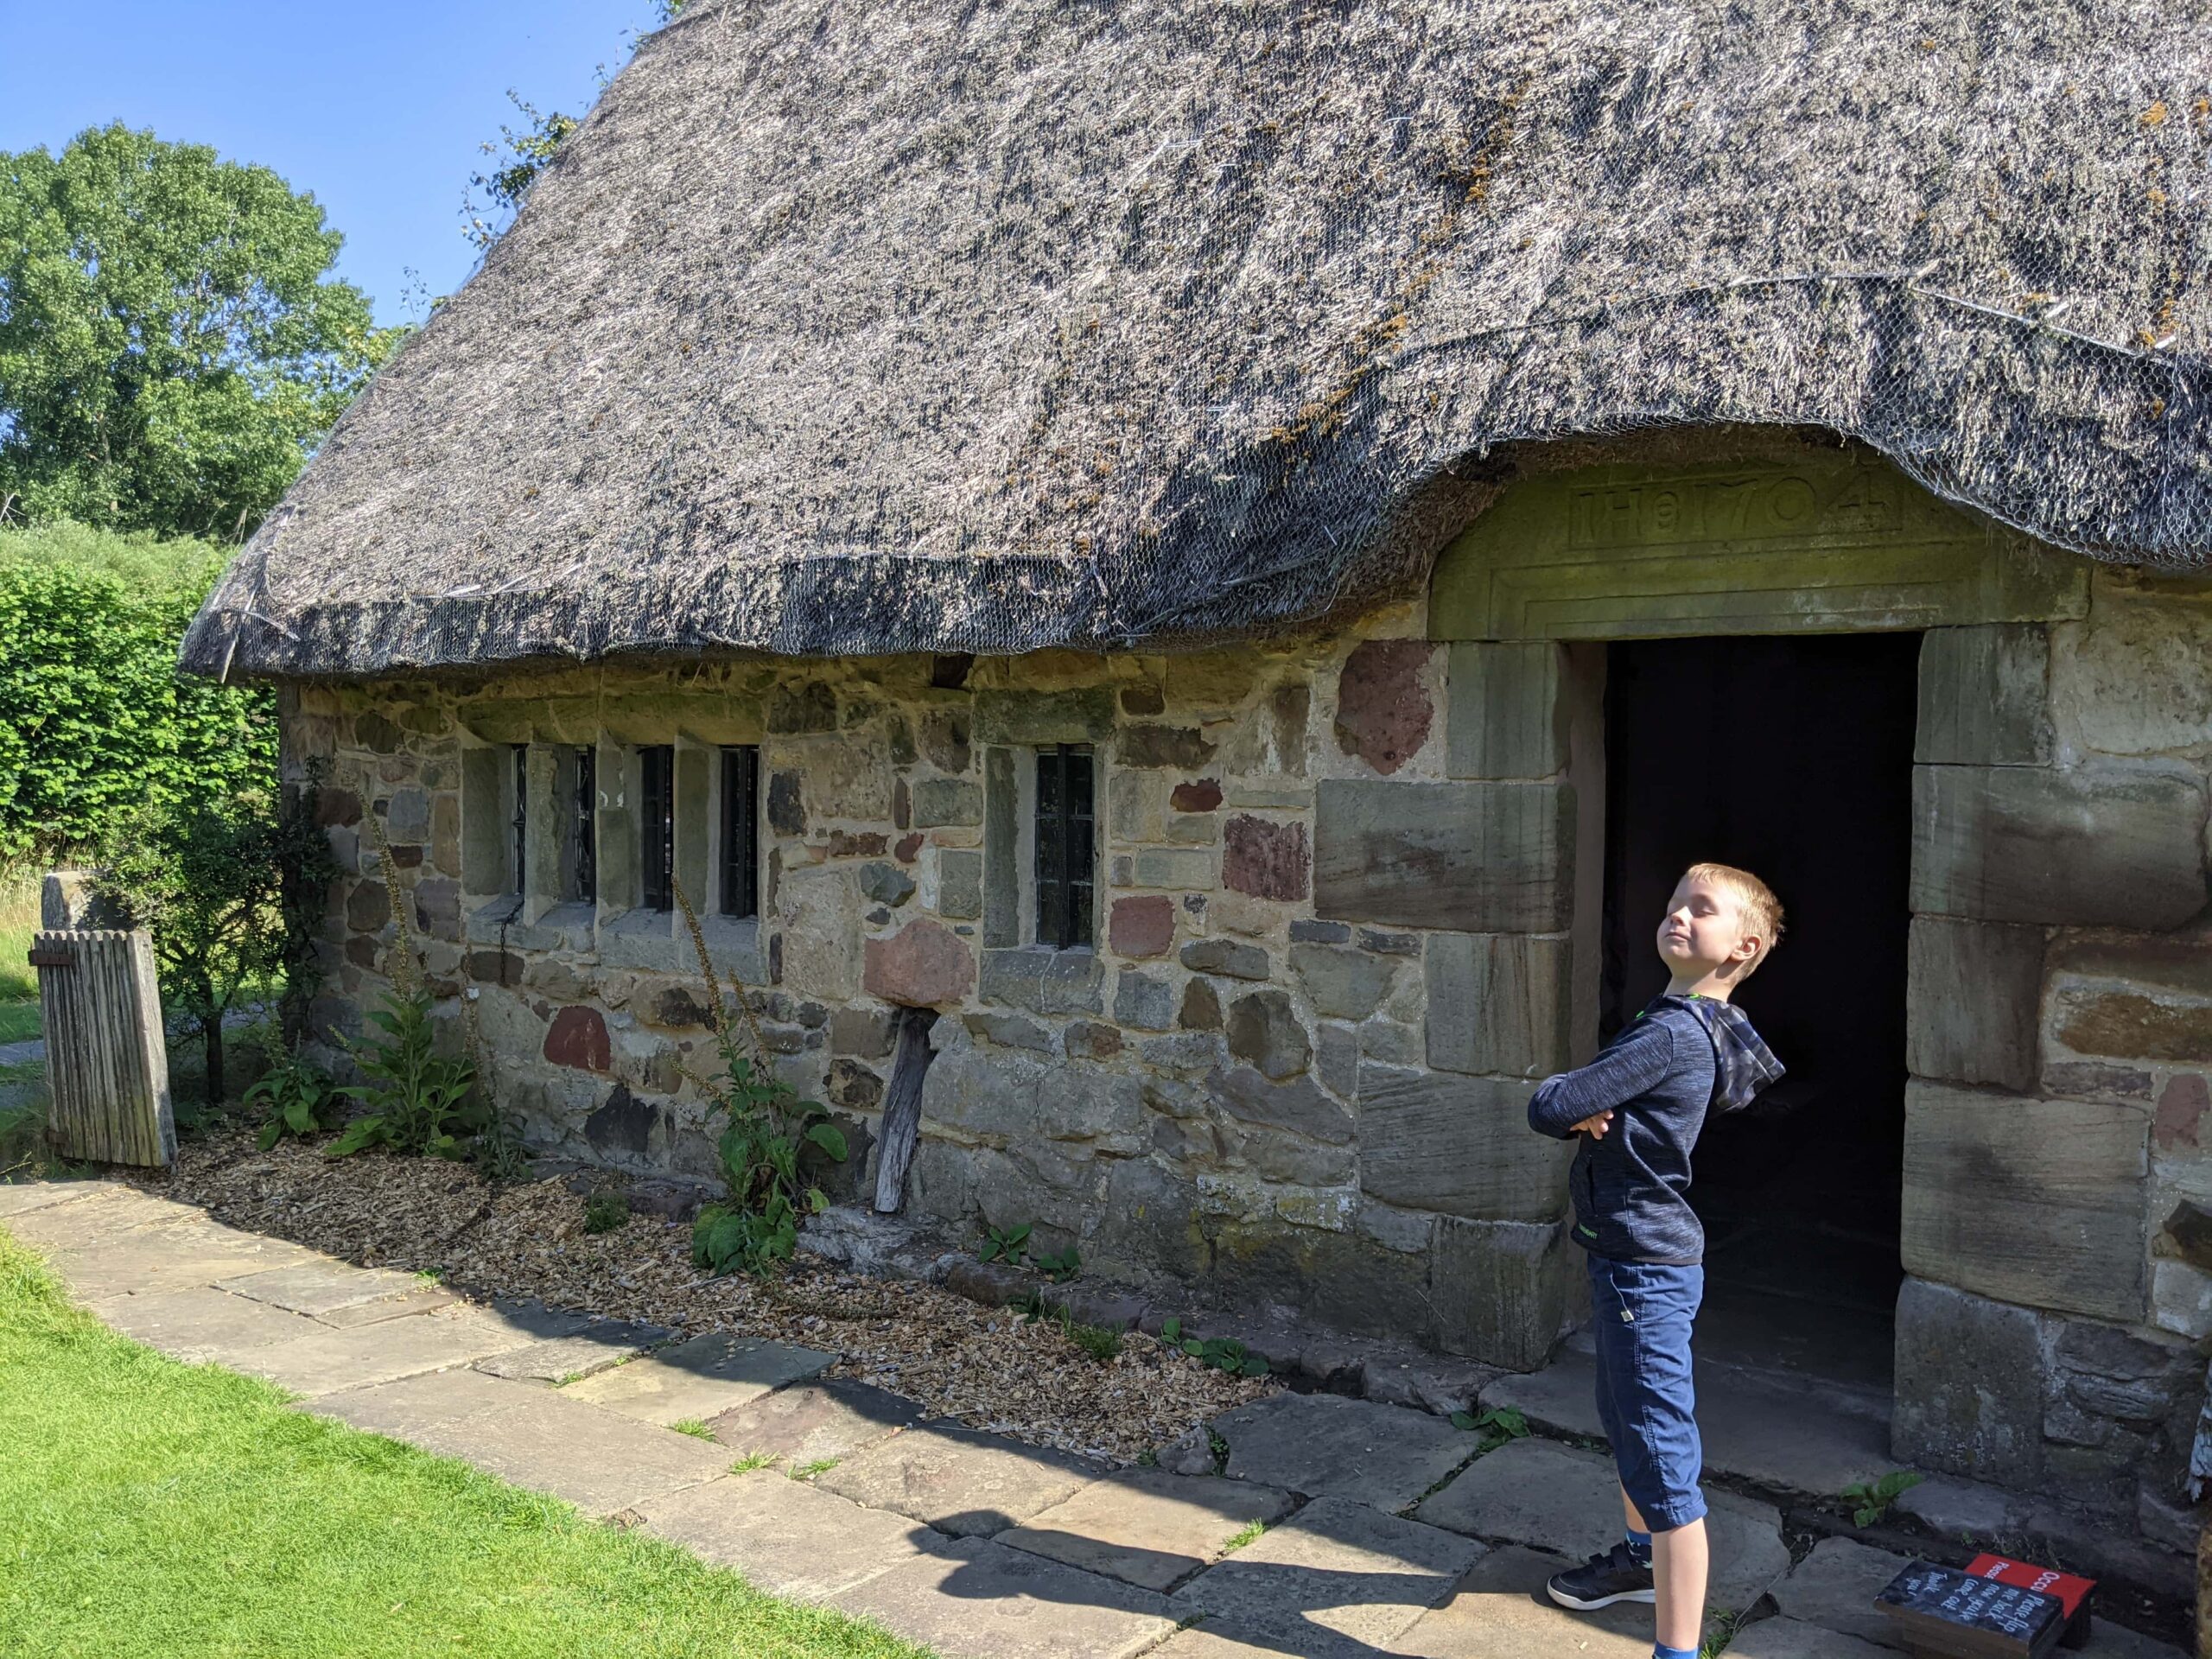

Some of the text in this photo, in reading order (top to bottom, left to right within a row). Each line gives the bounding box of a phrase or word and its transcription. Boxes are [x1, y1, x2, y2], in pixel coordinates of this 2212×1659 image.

[1923, 1572, 1948, 1593] Thank
[1980, 1583, 2000, 1600] now
[2029, 1571, 2061, 1593] Occu
[1985, 1588, 2020, 1620] me back
[2013, 1593, 2045, 1619] Please
